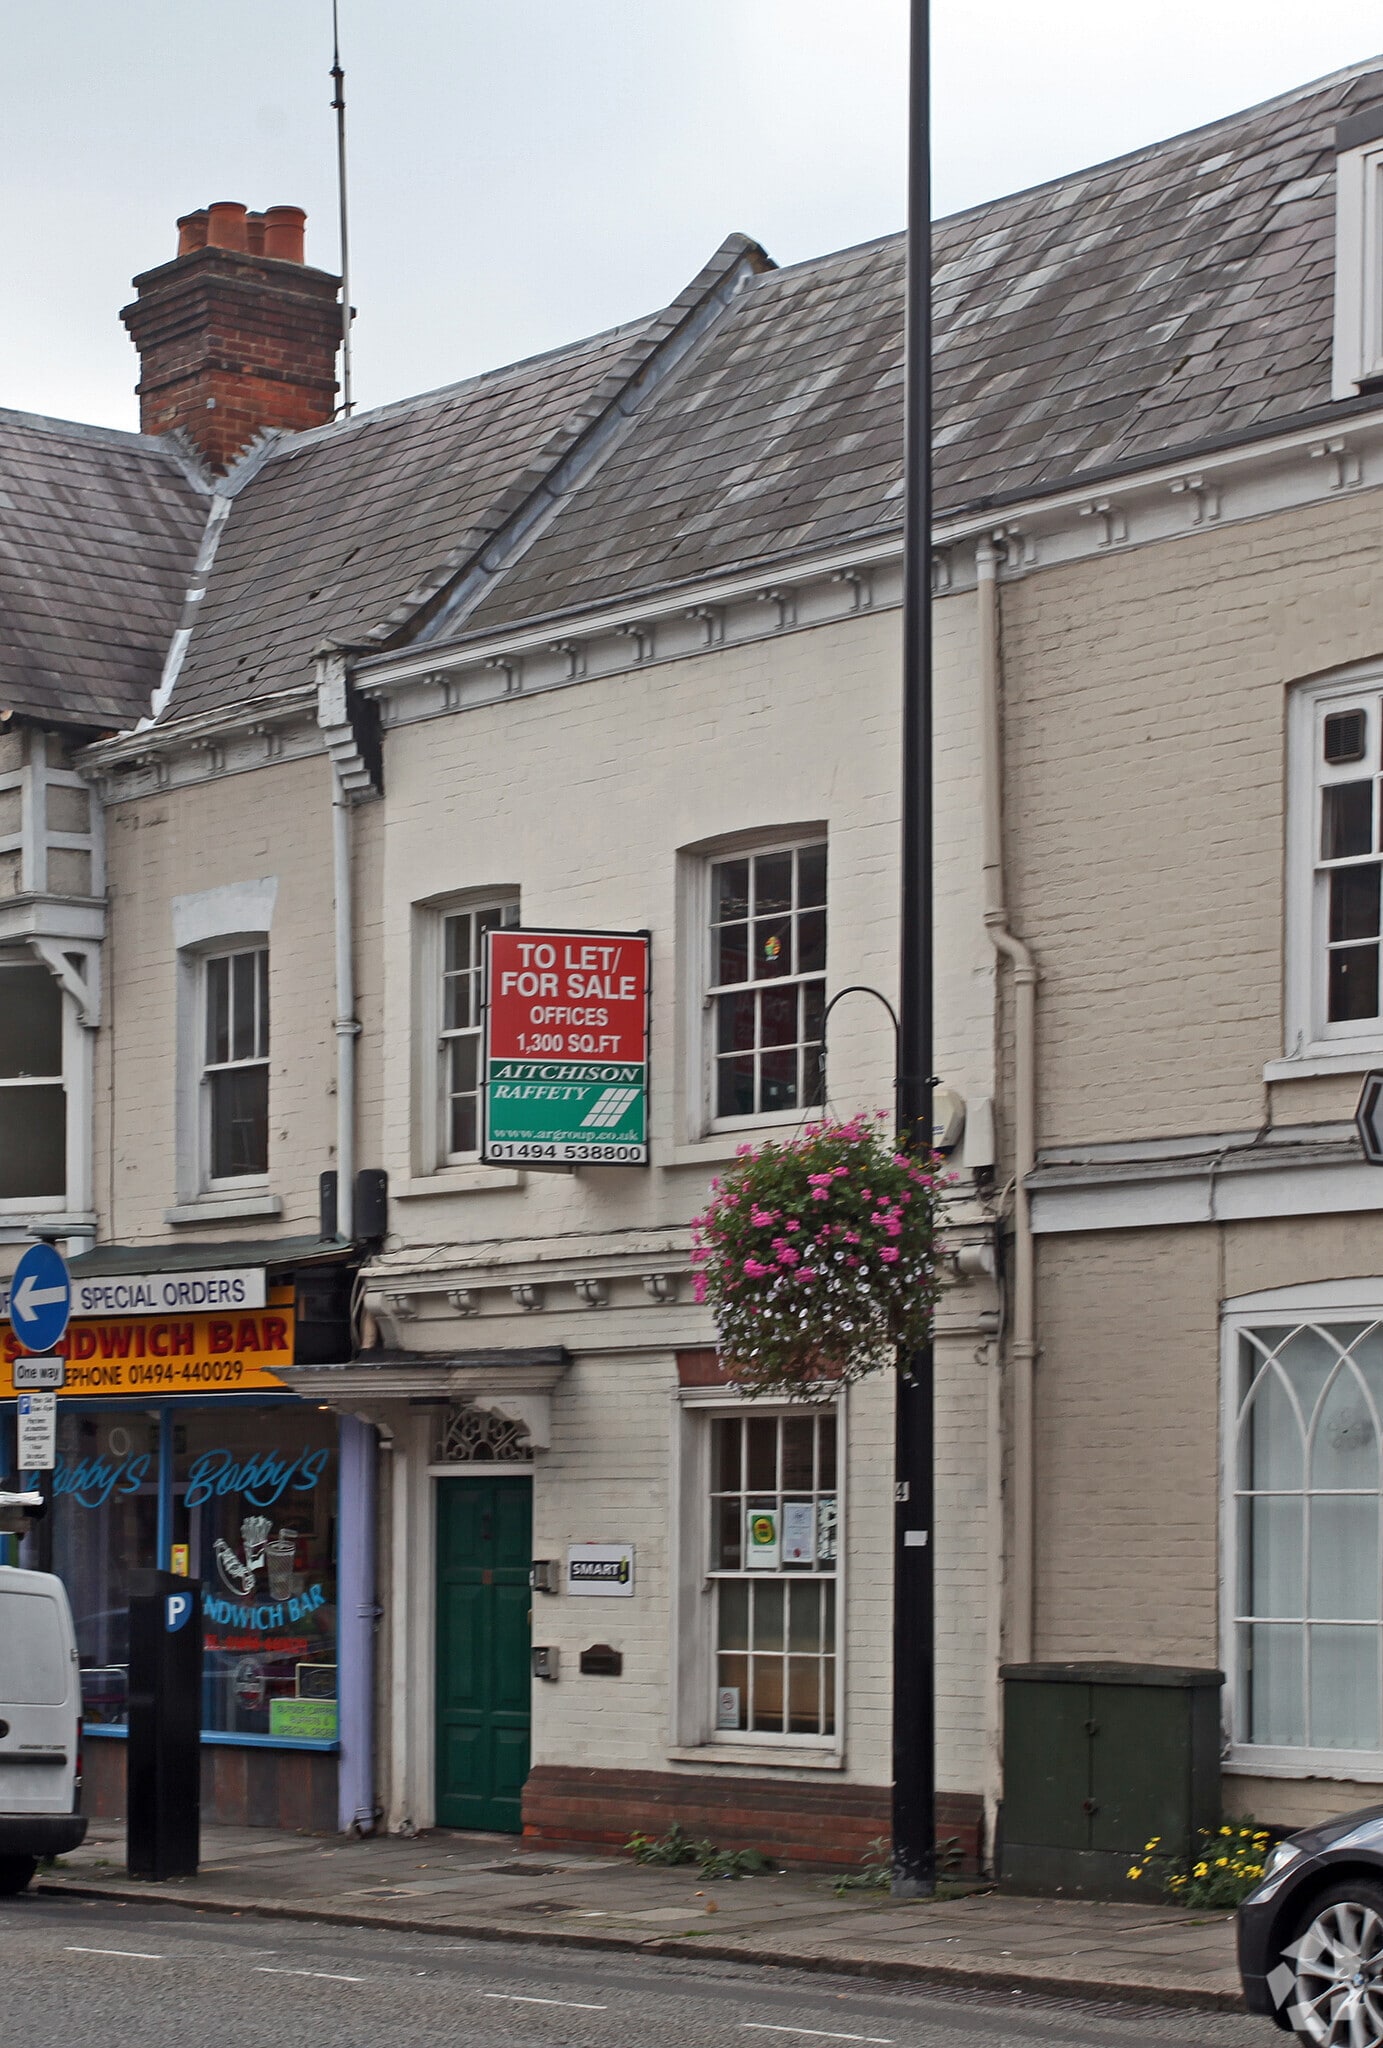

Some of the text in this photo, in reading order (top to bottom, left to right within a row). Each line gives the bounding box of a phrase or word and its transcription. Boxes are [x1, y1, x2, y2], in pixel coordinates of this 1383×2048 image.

[517, 943, 622, 974] TO LET/
[501, 971, 637, 1000] FOR SALE
[530, 1005, 609, 1027] OFFICES
[516, 1033, 622, 1054] 1,300 SQ.FT
[494, 1064, 640, 1082] AITCHISON
[494, 1085, 591, 1101] RAFFETY
[494, 1129, 639, 1142] www.argroup.co.uk
[491, 1143, 641, 1161] 01494 538800
[81, 1278, 246, 1311] SPECIAL ORDERS
[208, 1316, 290, 1355] BAR
[17, 1364, 60, 1381] One way
[128, 1360, 244, 1386] 01494-440029
[168, 1596, 186, 1625] P
[287, 1583, 326, 1623] BAR
